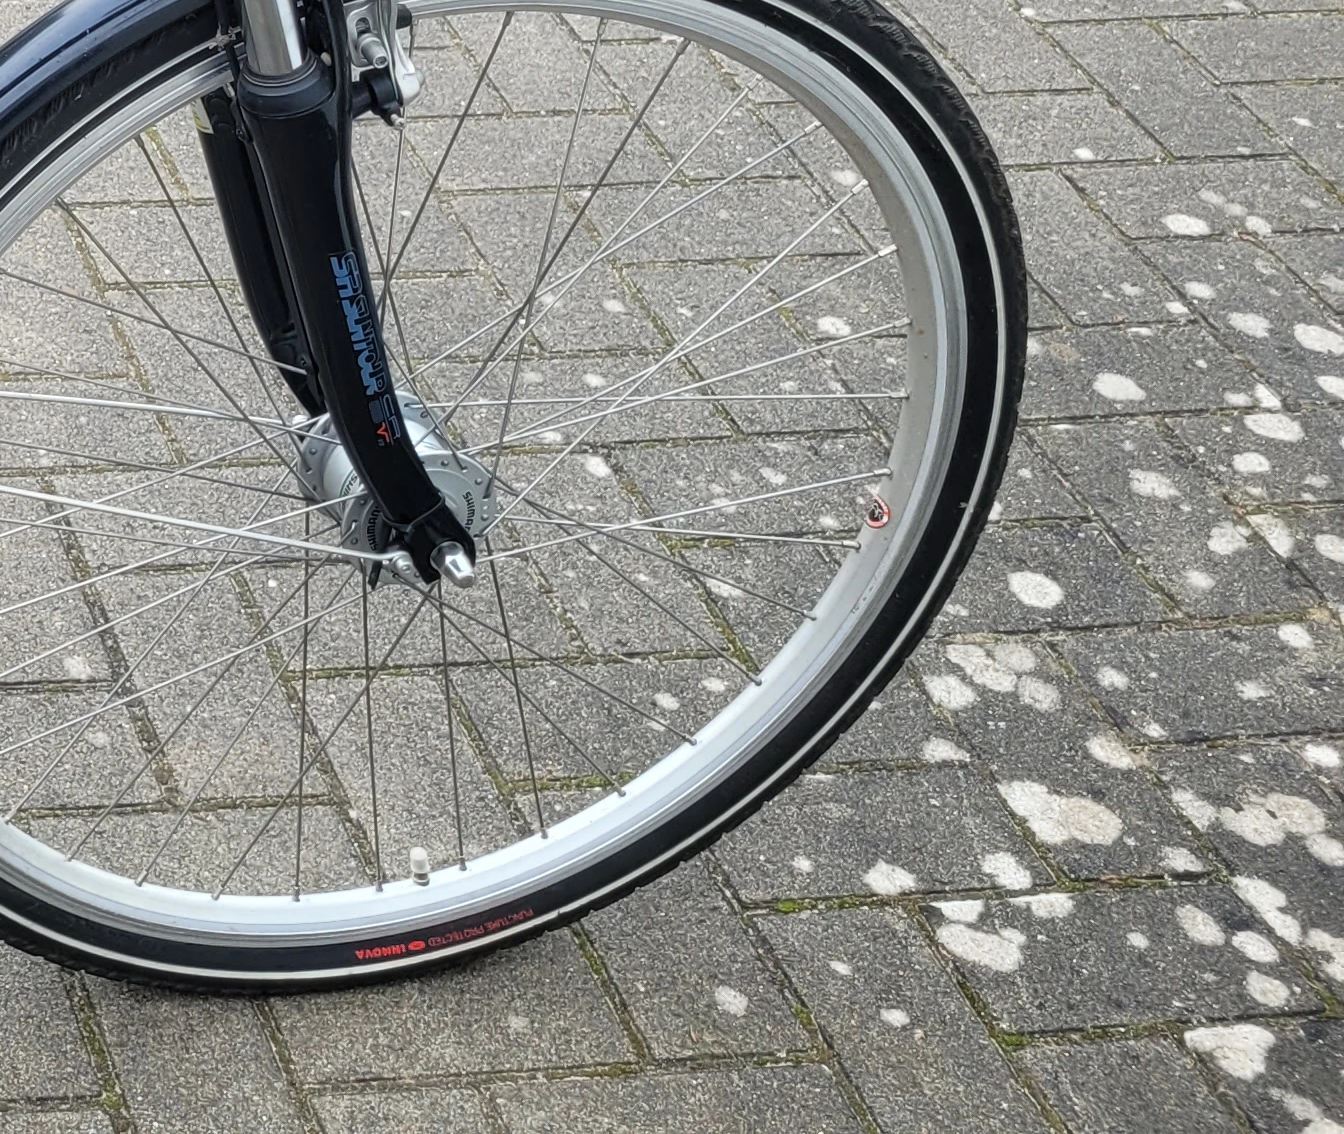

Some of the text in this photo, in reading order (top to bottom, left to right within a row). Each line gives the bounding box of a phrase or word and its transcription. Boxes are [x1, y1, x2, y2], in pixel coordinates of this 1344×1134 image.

[330, 251, 387, 396] SR SUNTOUR
[366, 506, 381, 551] SHIMAN
[355, 943, 407, 960] INNOVA
[428, 924, 485, 947] PROTECTED
